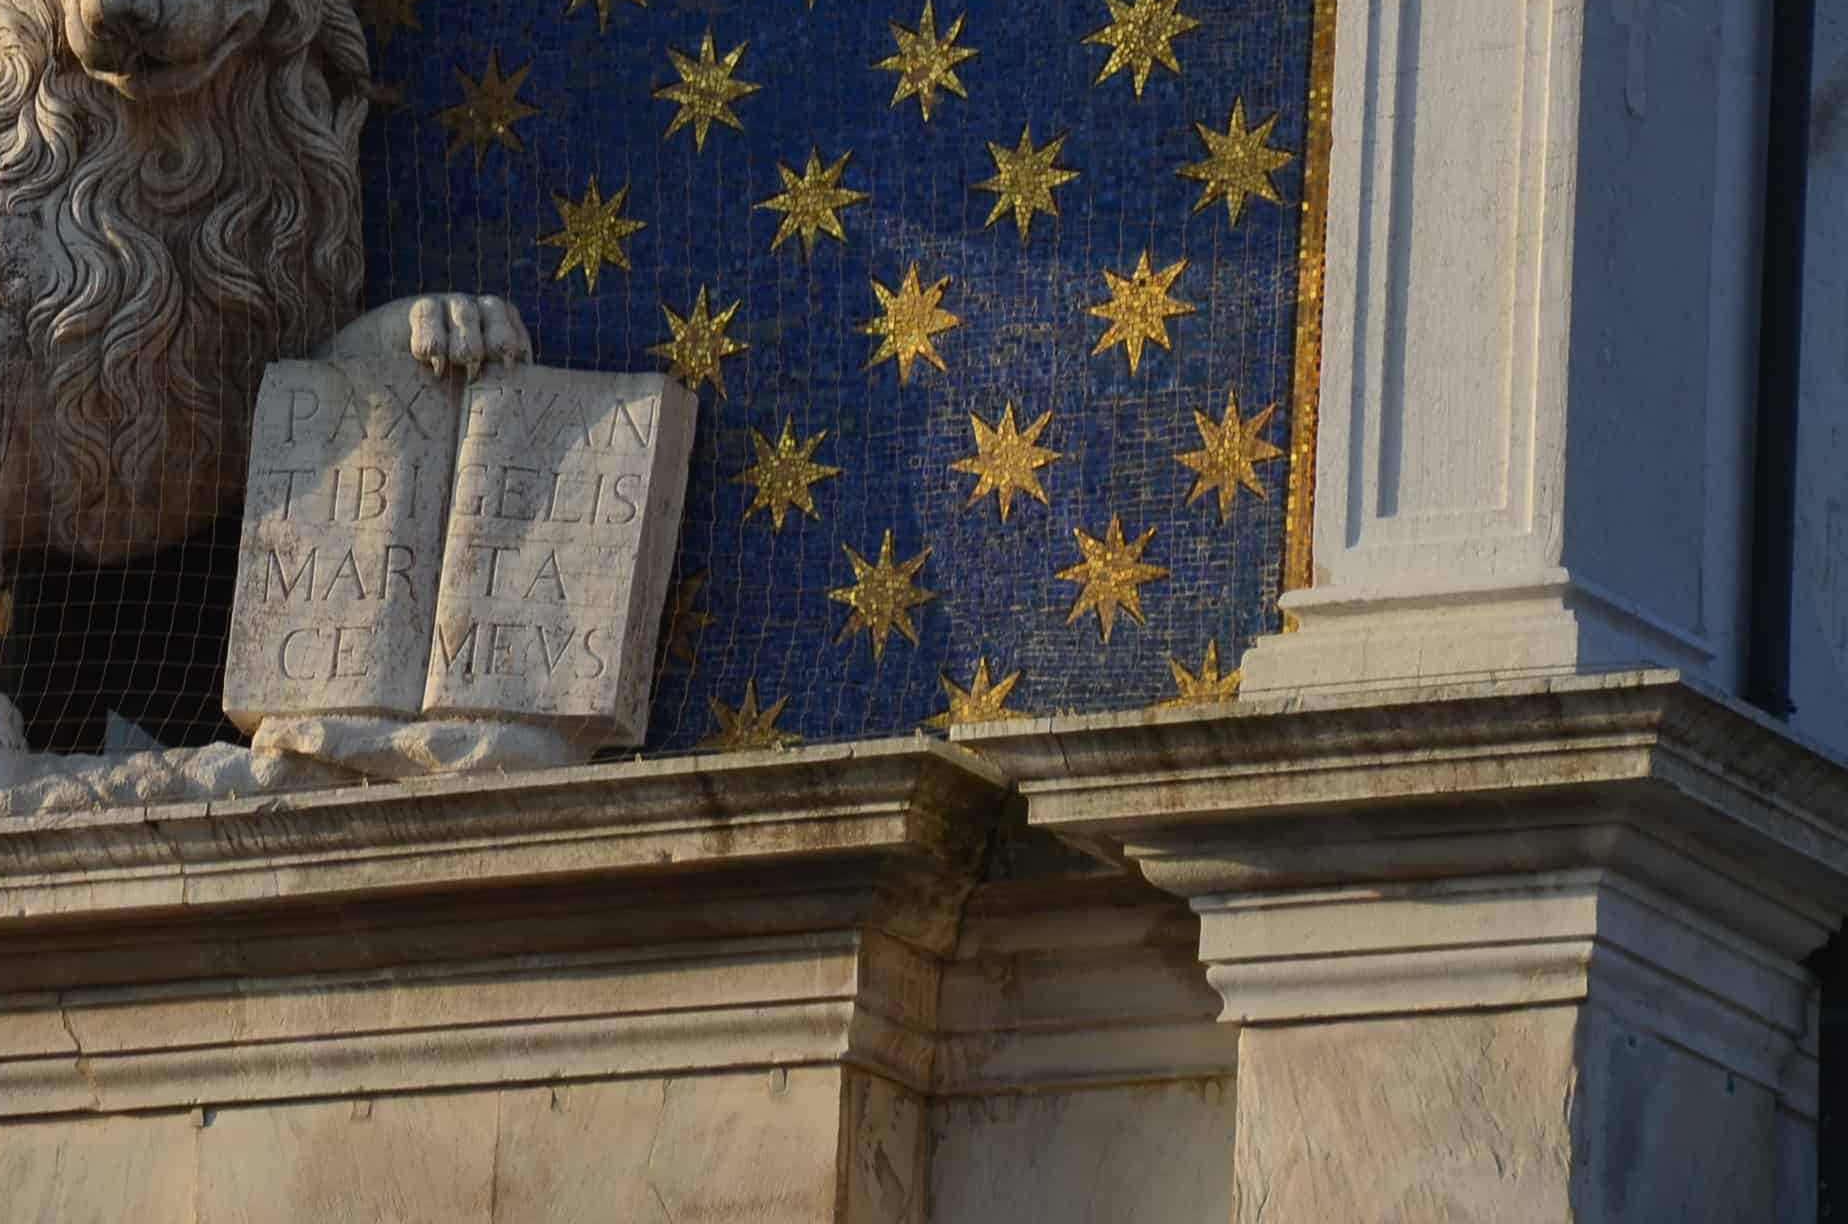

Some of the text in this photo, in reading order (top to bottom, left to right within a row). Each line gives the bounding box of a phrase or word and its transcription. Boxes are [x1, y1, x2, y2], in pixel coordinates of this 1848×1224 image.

[285, 384, 432, 445] PAX
[469, 385, 658, 449] EVAN
[261, 464, 420, 522] TIBI
[454, 464, 643, 525] GELIS
[262, 544, 417, 603] MAR
[468, 545, 568, 601] TA
[278, 626, 376, 681] CE
[433, 623, 607, 681] MEVS
